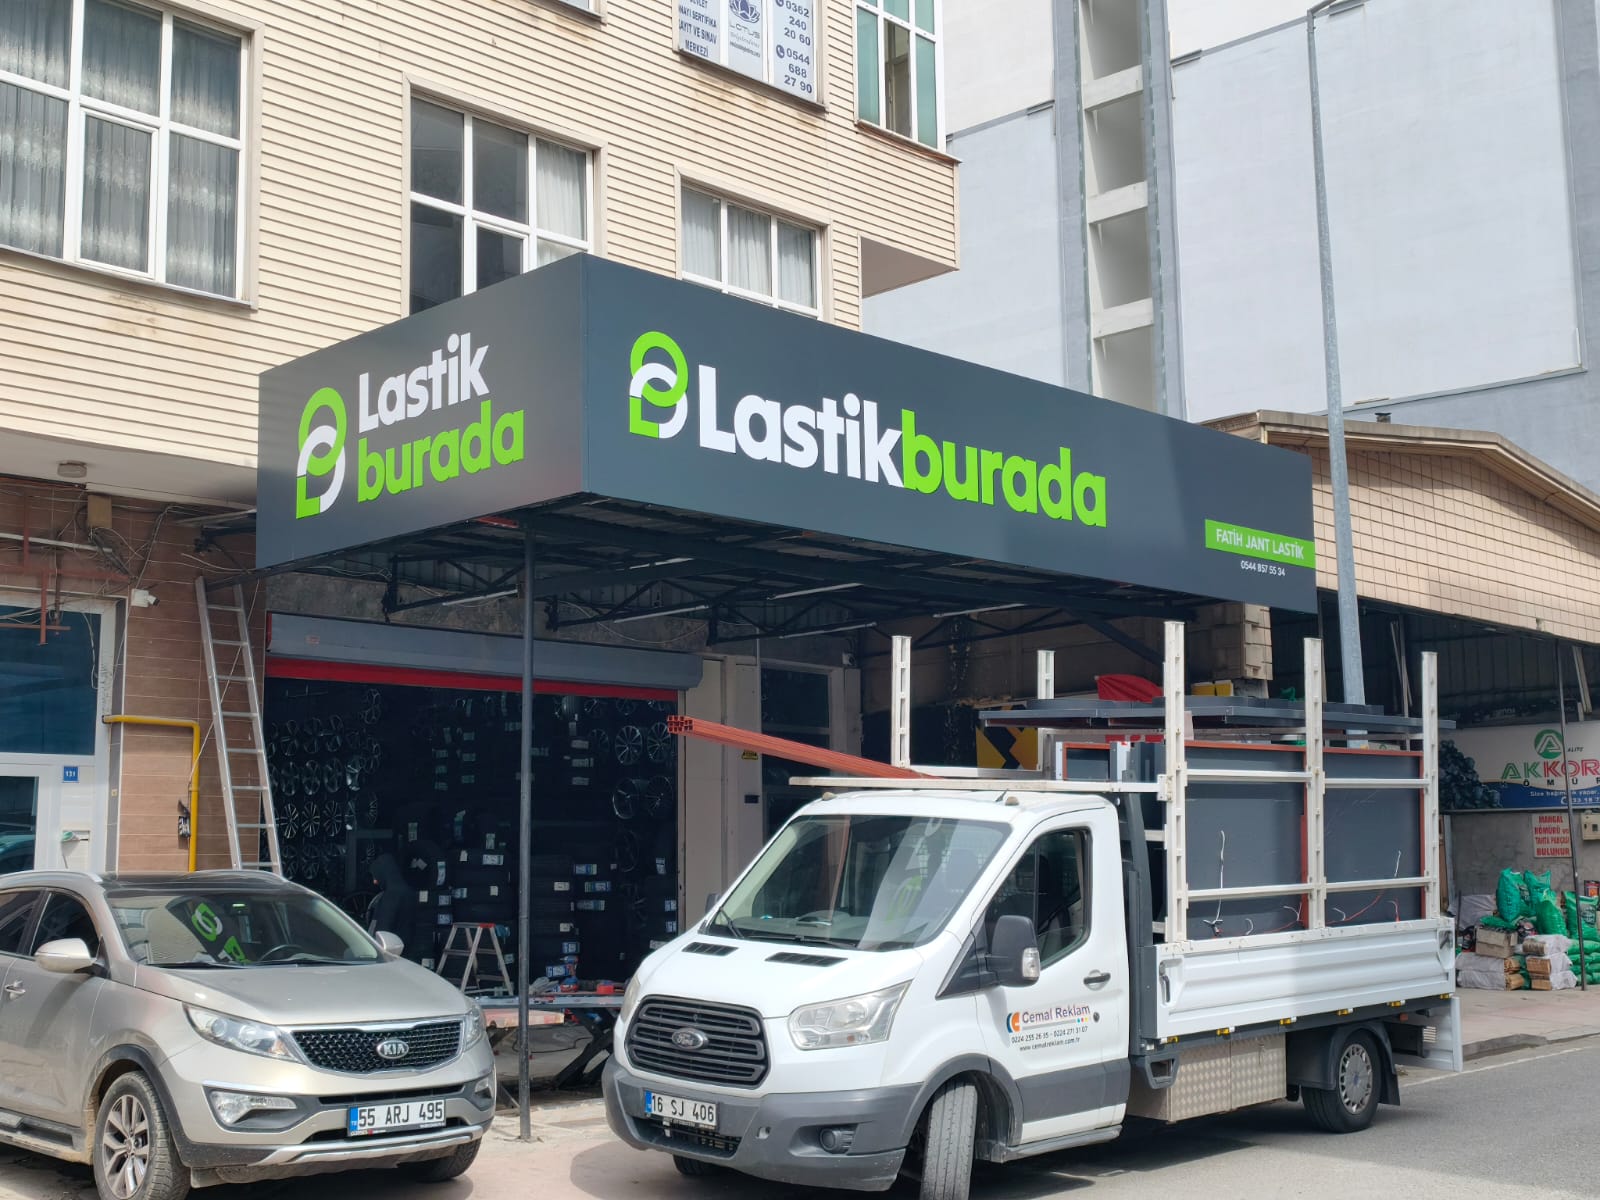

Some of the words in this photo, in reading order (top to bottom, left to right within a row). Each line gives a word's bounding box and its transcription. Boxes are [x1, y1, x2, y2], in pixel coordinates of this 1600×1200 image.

[786, 0, 810, 18] 0362
[789, 16, 807, 31] 240
[784, 27, 796, 39] 20
[799, 34, 811, 46] 60
[786, 48, 810, 65] 0544
[788, 63, 807, 79] 688
[784, 74, 797, 87] 27
[800, 81, 812, 94] 90
[358, 332, 490, 434] Lastik
[357, 399, 525, 504] burada
[699, 364, 1107, 528] Lastikburada
[1216, 528, 1242, 546] FATİH
[1245, 535, 1270, 552] JANT
[1272, 541, 1304, 559] LASTİK
[1240, 560, 1257, 571] 0544
[1269, 565, 1277, 575] 55
[1277, 567, 1286, 577] 34
[1022, 1011, 1053, 1023] Cemal
[1055, 1003, 1091, 1018] Reklam
[383, 1043, 405, 1056] KIA
[358, 1108, 376, 1128] 55
[385, 1104, 410, 1125] ARJ
[418, 1101, 443, 1121] 495
[652, 1094, 663, 1113] 16
[670, 1099, 684, 1117] SJ
[692, 1103, 715, 1122] 406
